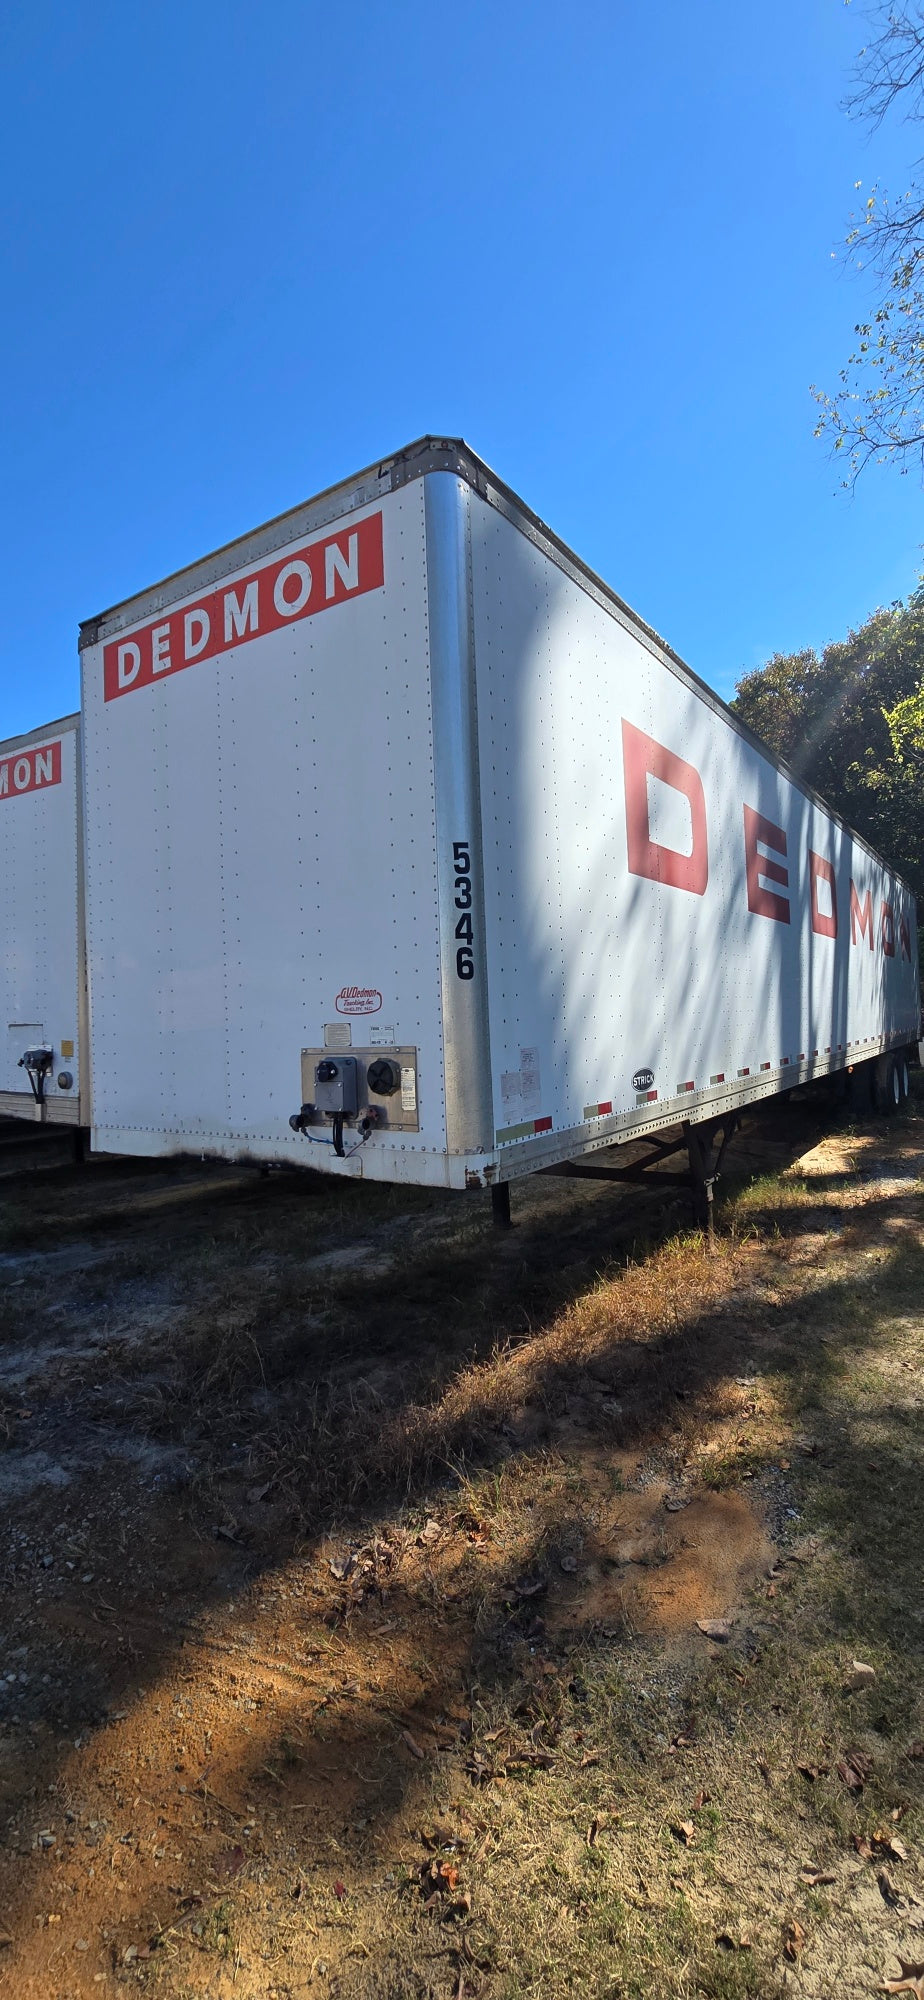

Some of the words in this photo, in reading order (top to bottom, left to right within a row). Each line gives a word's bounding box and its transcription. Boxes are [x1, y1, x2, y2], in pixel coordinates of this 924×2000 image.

[118, 532, 359, 690] DEDMON
[453, 842, 475, 980] 5346
[621, 717, 912, 963] DEDMON
[633, 1074, 655, 1088] STRICK
